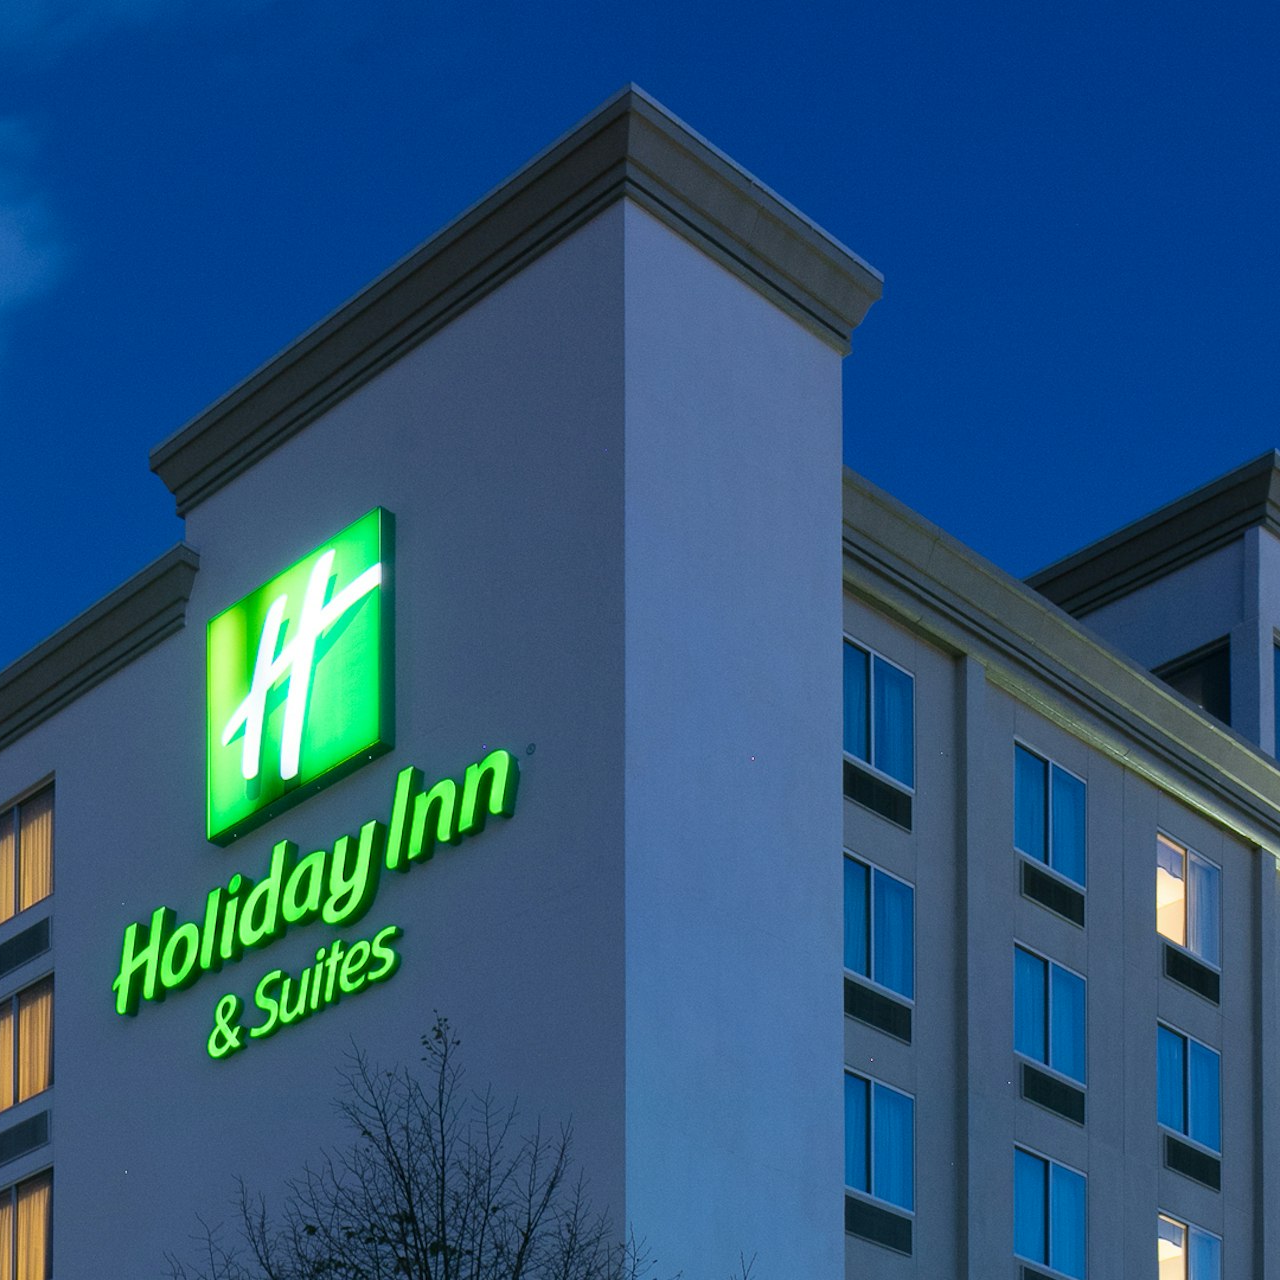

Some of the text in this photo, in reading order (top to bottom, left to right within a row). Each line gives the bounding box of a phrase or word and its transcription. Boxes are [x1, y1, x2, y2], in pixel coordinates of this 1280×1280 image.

[220, 548, 383, 781] H
[112, 748, 517, 1016] Holiday Inn
[207, 925, 401, 1059] & Suites
